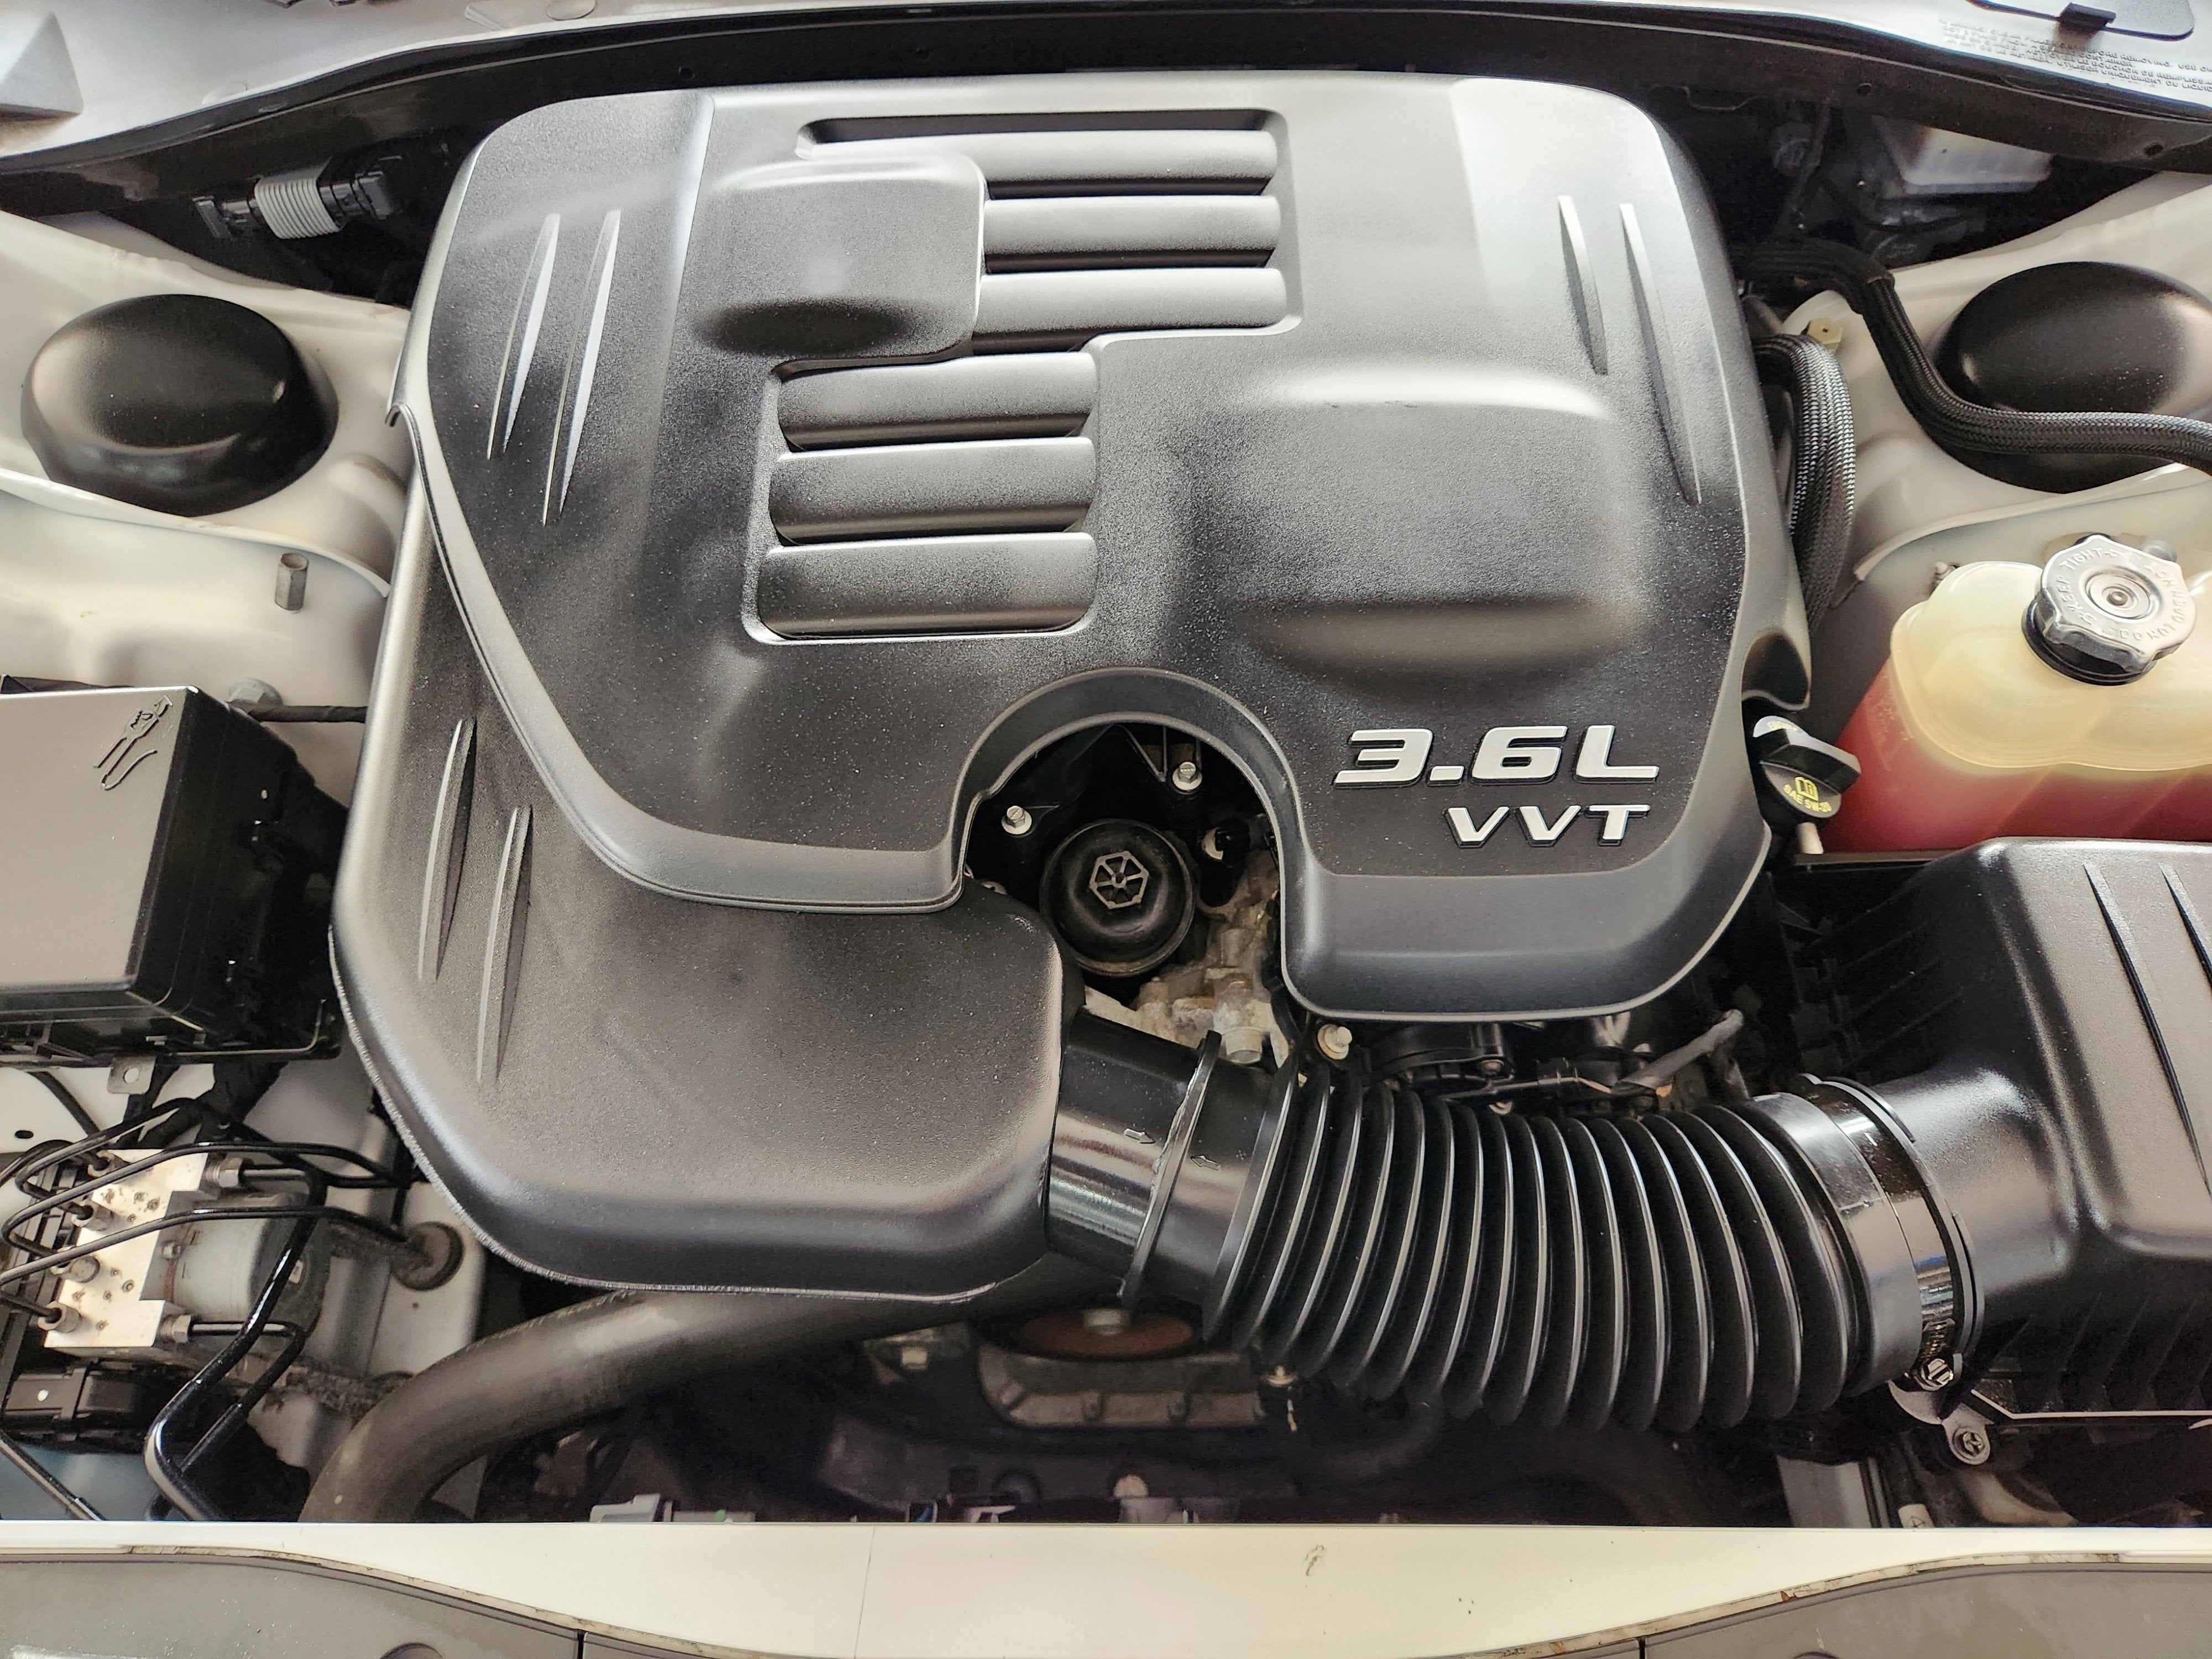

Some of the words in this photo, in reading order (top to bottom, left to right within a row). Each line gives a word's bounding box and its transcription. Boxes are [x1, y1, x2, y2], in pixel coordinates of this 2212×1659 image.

[2059, 547, 2103, 571] TIGHT
[2056, 574, 2084, 612] KEEP
[2120, 628, 2143, 640] DO
[2146, 622, 2176, 640] NOT
[1334, 724, 1659, 784] 3.6L
[1783, 784, 1803, 805] SAE
[1447, 805, 1651, 843] VVT
